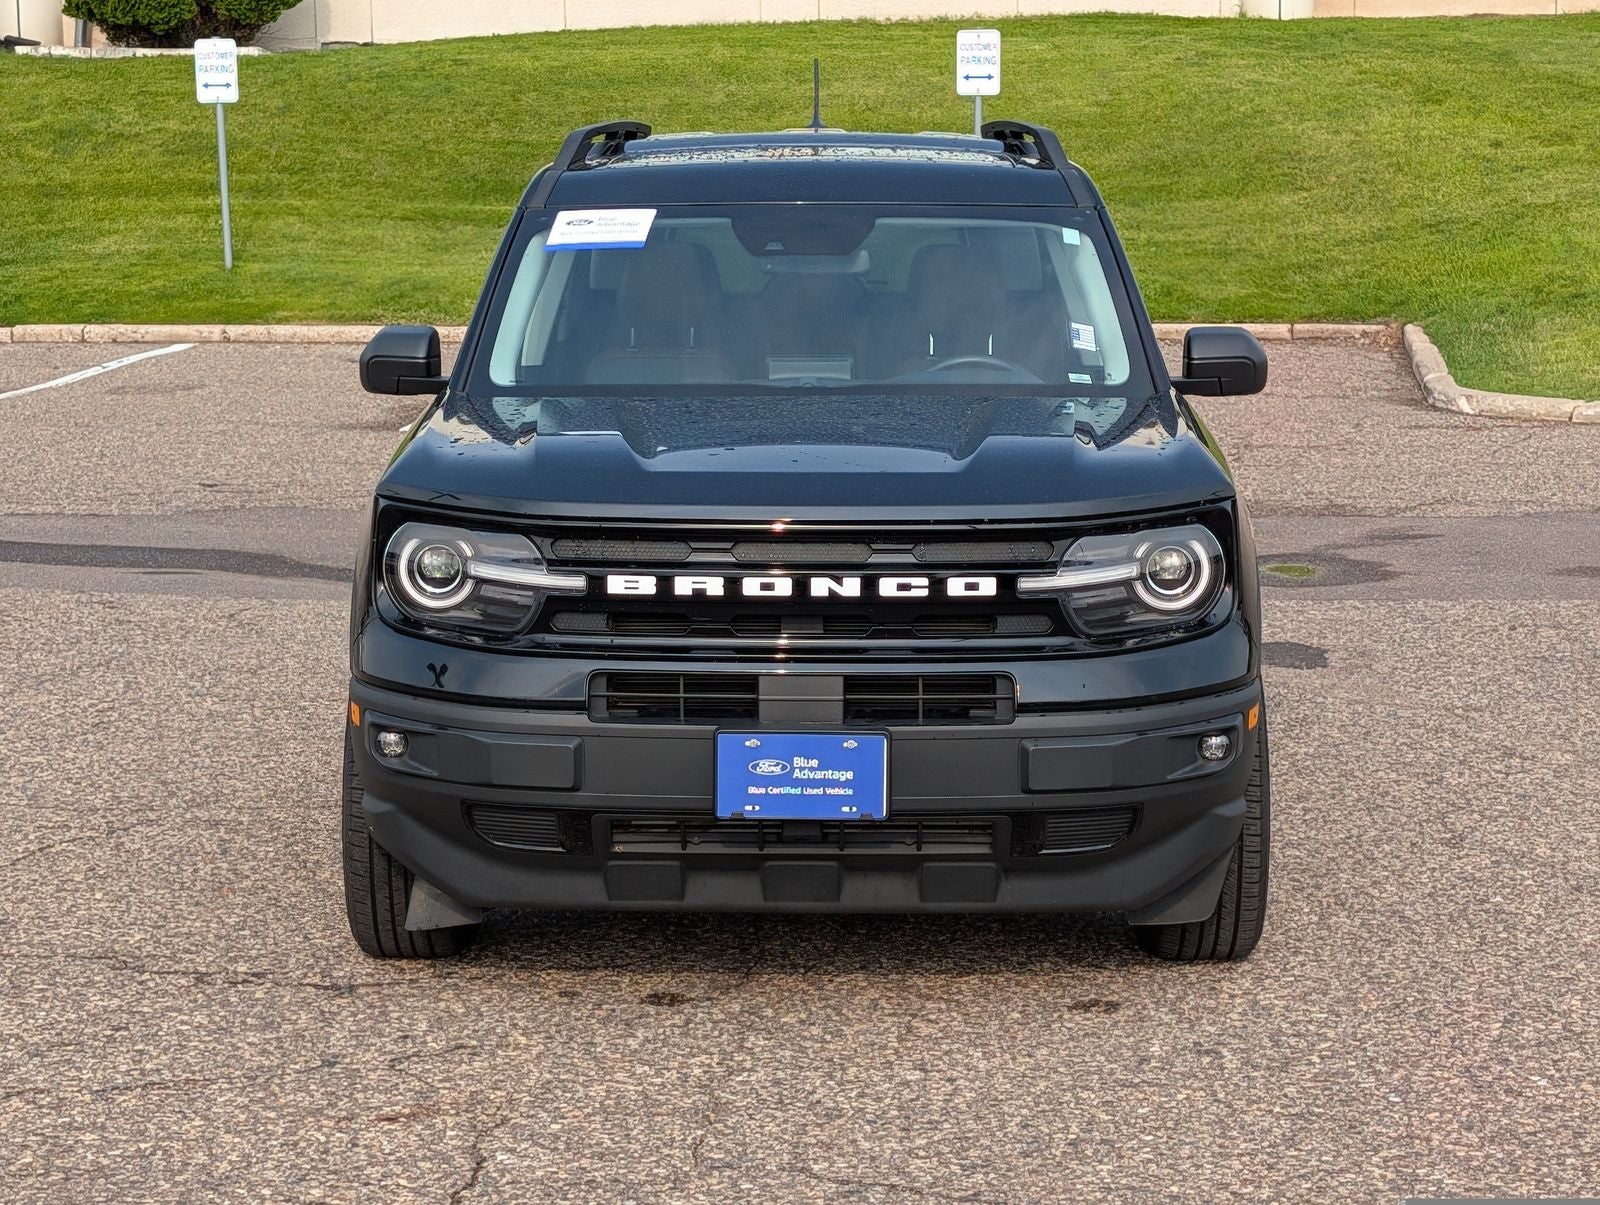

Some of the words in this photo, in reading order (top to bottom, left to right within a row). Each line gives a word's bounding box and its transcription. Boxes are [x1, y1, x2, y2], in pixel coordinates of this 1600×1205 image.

[960, 56, 997, 65] PARKING
[199, 64, 234, 73] PARKING
[606, 574, 997, 596] BRONCO
[756, 761, 782, 773] Ford
[793, 757, 819, 768] Blue
[793, 769, 853, 781] Advantage
[748, 786, 766, 794] Blue
[767, 786, 801, 794] Certified
[803, 787, 823, 795] Used
[825, 787, 853, 795] Vehicle
